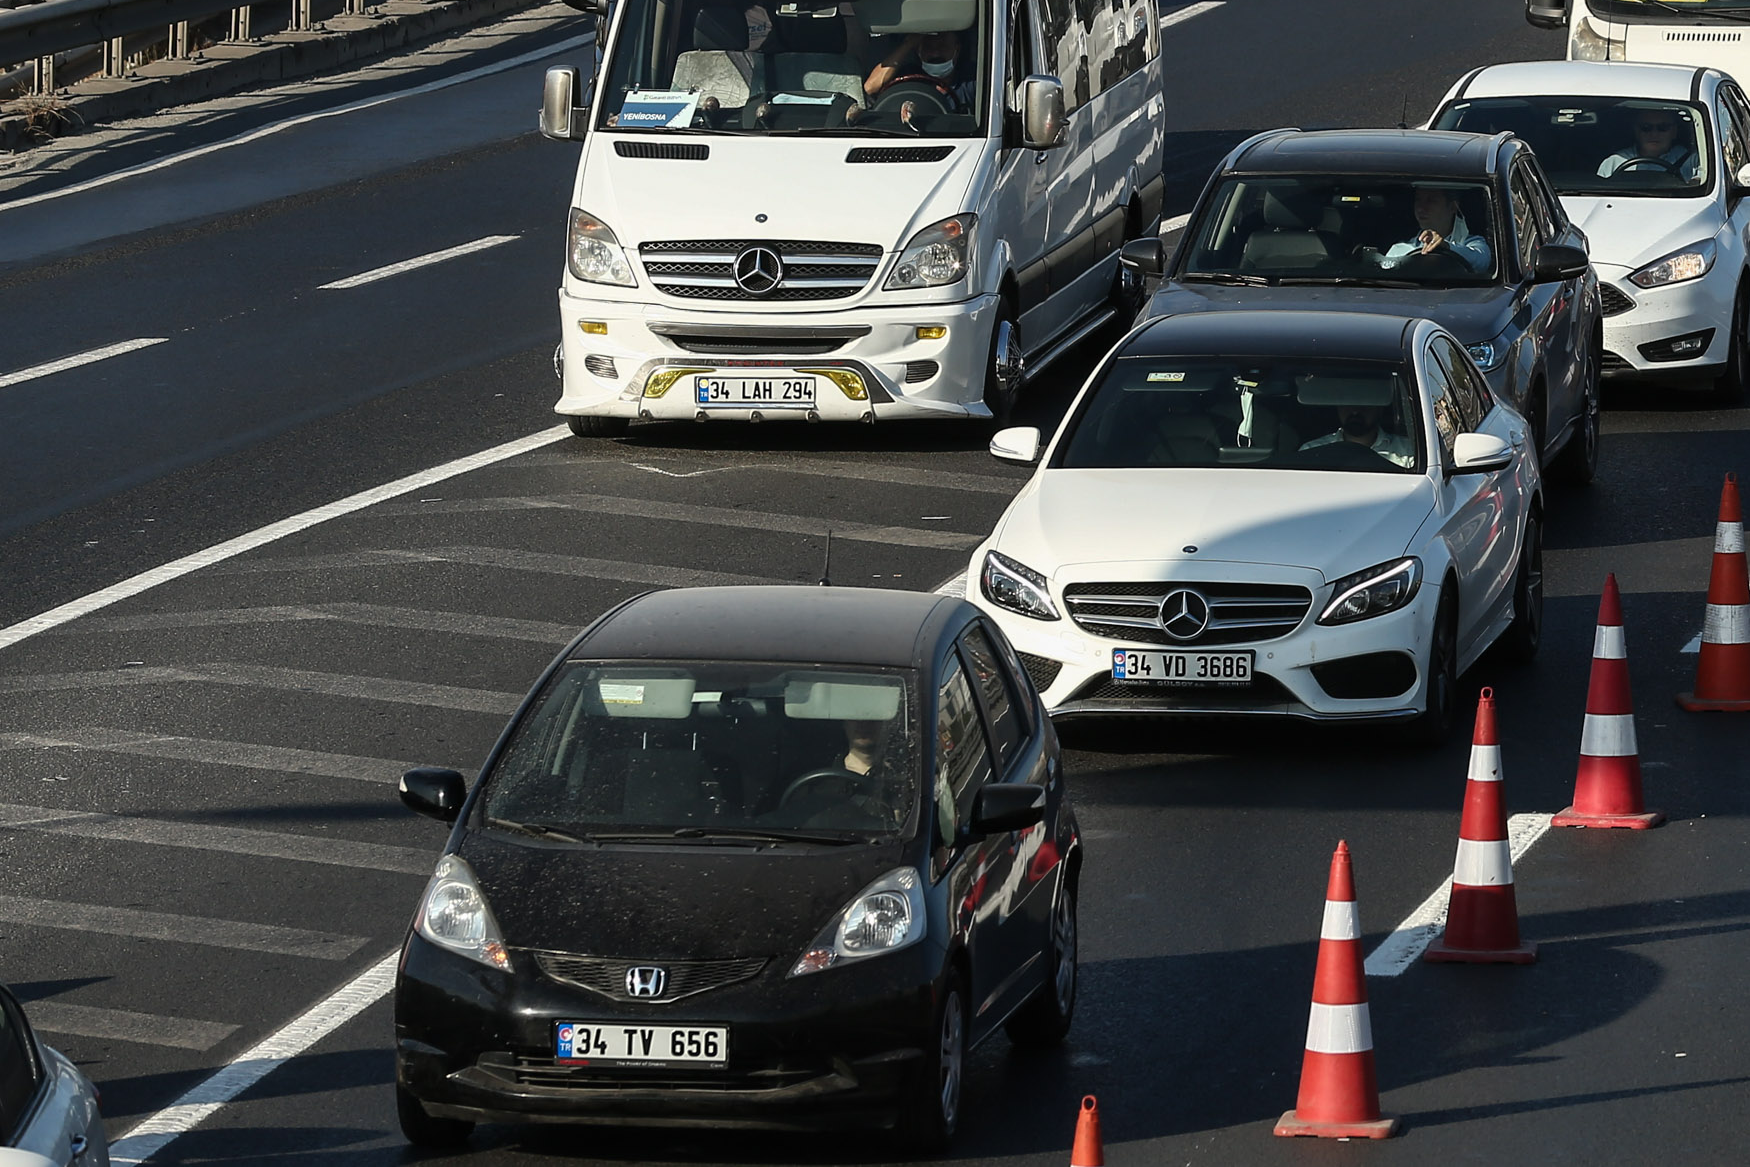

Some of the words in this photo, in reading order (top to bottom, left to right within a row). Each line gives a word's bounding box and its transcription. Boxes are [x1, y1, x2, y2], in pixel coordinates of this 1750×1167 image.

[623, 112, 666, 121] YENİBOSNA
[710, 381, 730, 399] 34
[742, 381, 773, 400] LAH
[782, 381, 813, 400] 294
[1116, 666, 1125, 674] TR
[1127, 654, 1152, 676] 34
[1163, 655, 1187, 677] VD
[1196, 656, 1248, 678] 3686
[560, 1042, 572, 1052] TR
[576, 1028, 608, 1055] 34
[623, 1029, 654, 1056] TV
[670, 1030, 718, 1058] 656
